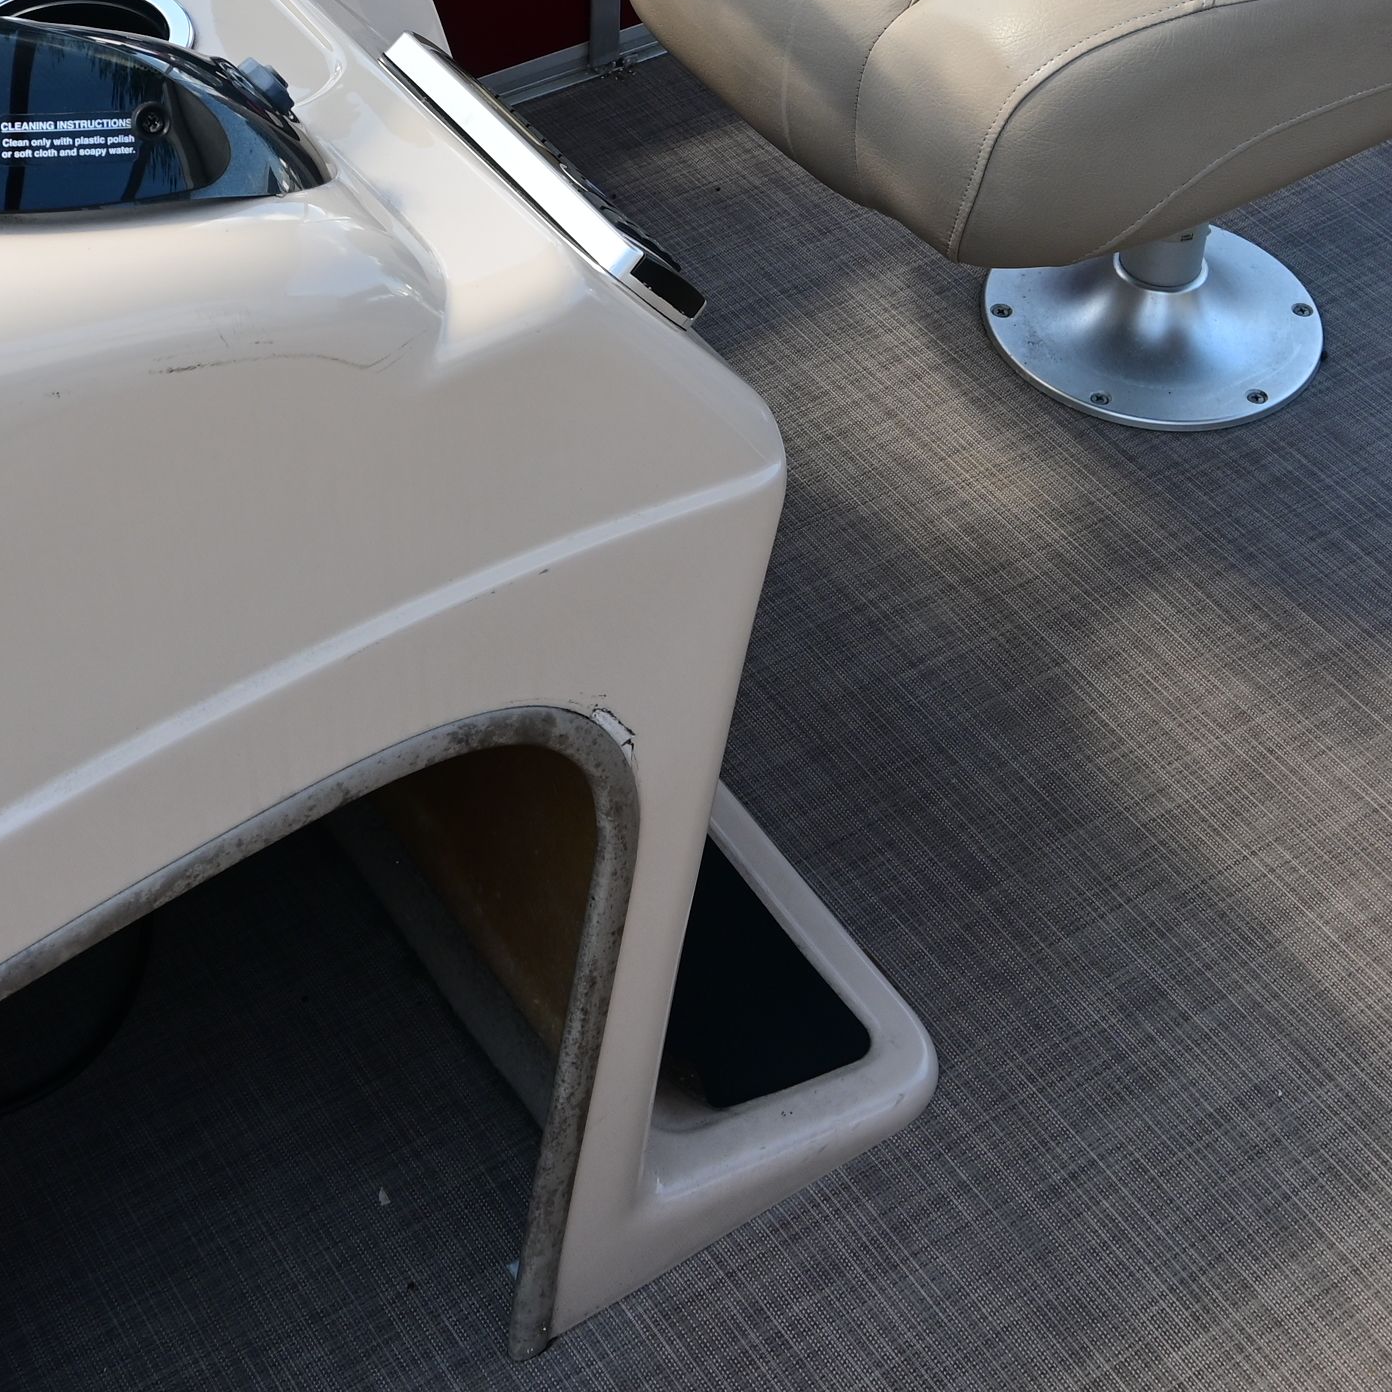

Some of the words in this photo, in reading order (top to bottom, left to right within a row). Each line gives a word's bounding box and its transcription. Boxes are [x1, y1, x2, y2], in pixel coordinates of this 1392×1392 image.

[0, 120, 54, 132] CLEANING
[56, 118, 132, 130] INSTRUCTIONS
[2, 138, 29, 148] Clean
[31, 137, 51, 148] only
[53, 136, 72, 146] with
[74, 135, 105, 146] plastic
[107, 134, 135, 146] polish
[1, 151, 12, 159] or
[14, 149, 32, 158] soft
[34, 148, 57, 157] cloth
[59, 147, 77, 157] and
[79, 147, 106, 156] soapy
[108, 146, 136, 155] water.
